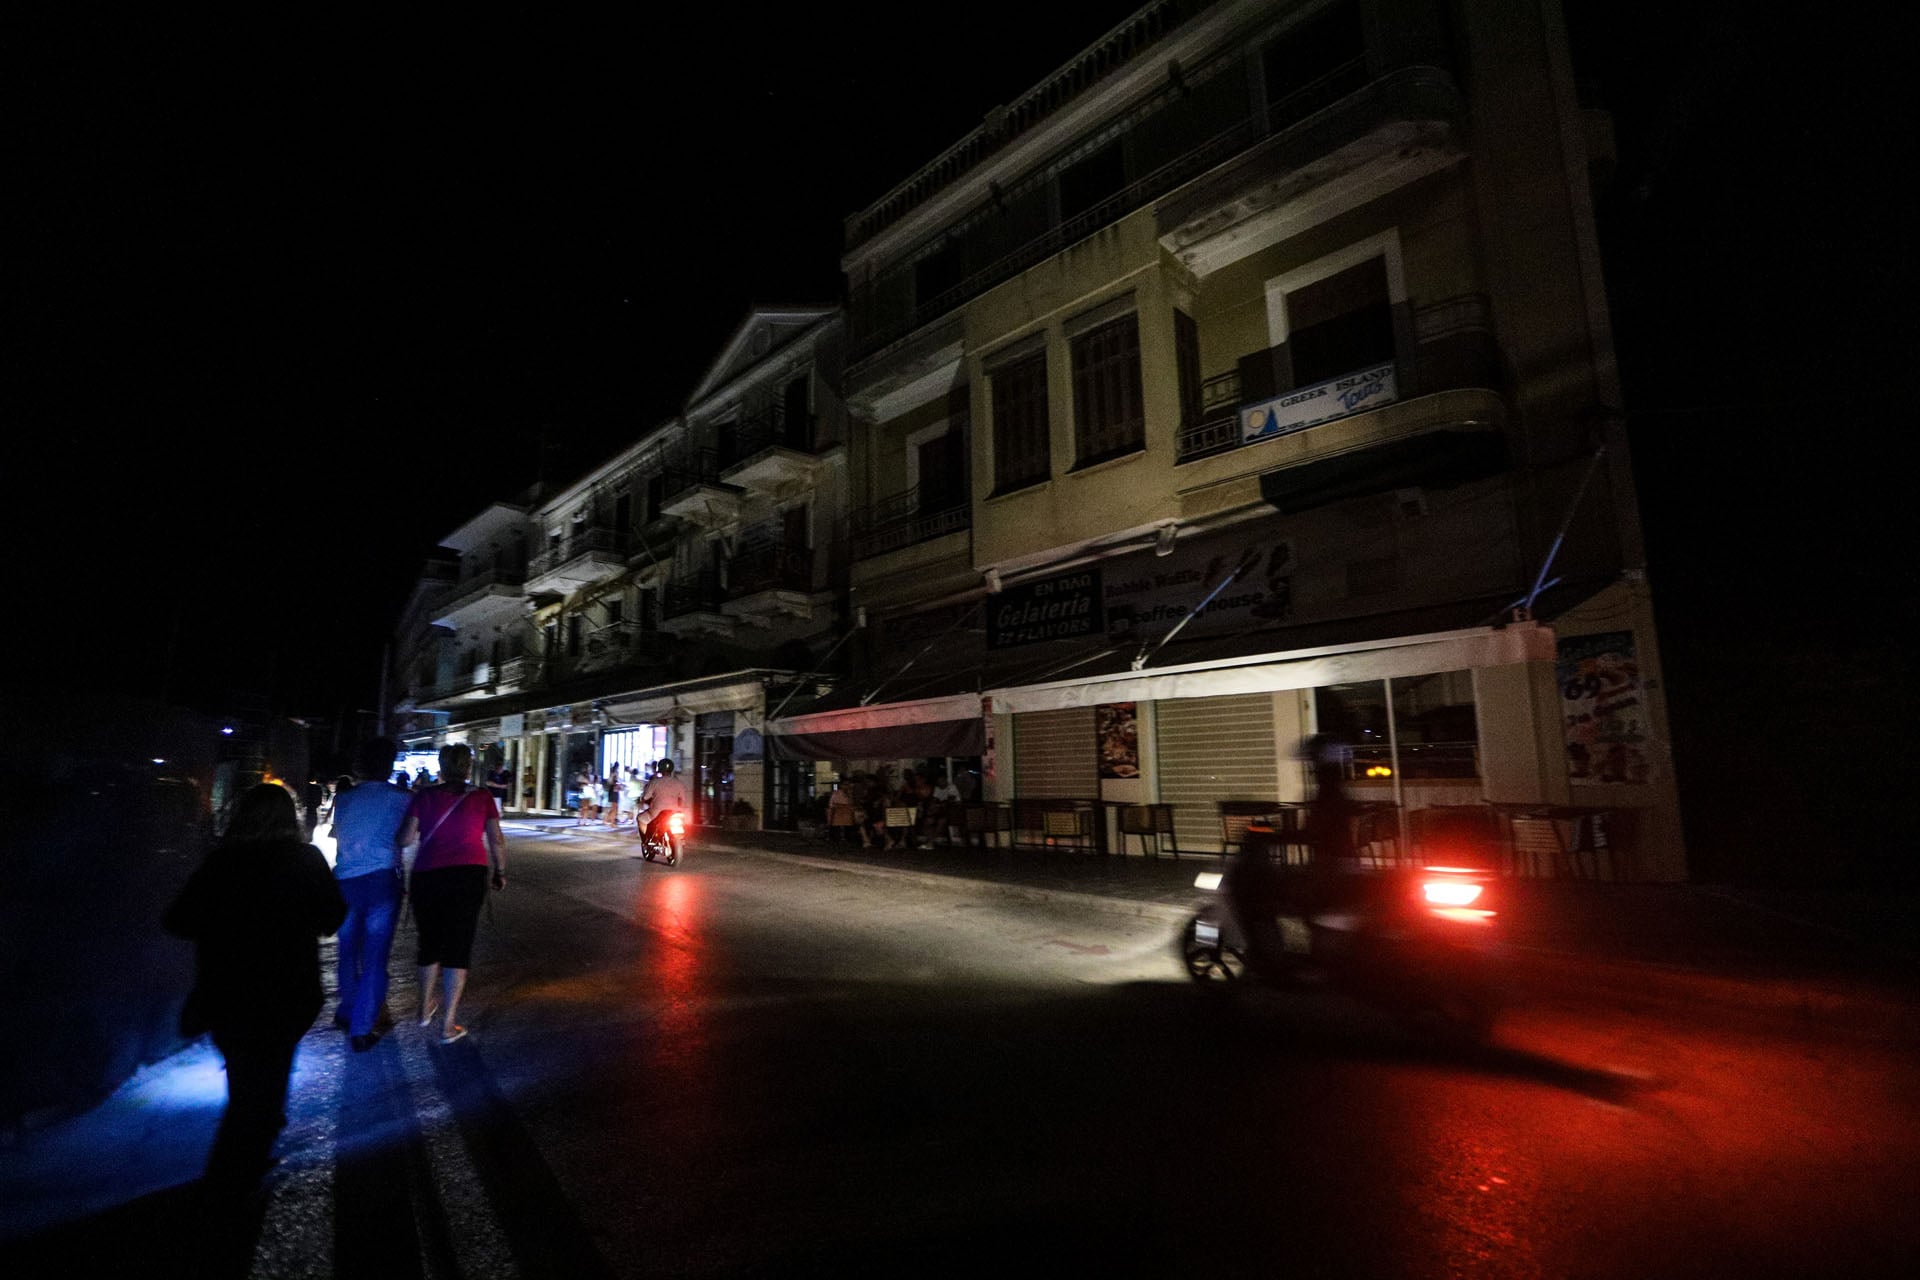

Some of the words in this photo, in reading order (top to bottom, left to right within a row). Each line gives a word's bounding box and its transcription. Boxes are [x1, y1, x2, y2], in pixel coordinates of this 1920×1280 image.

[1281, 386, 1328, 408] GREEK
[1335, 367, 1392, 392] ISLAND
[1338, 381, 1384, 410] Tours
[996, 592, 1092, 629] Gelateria
